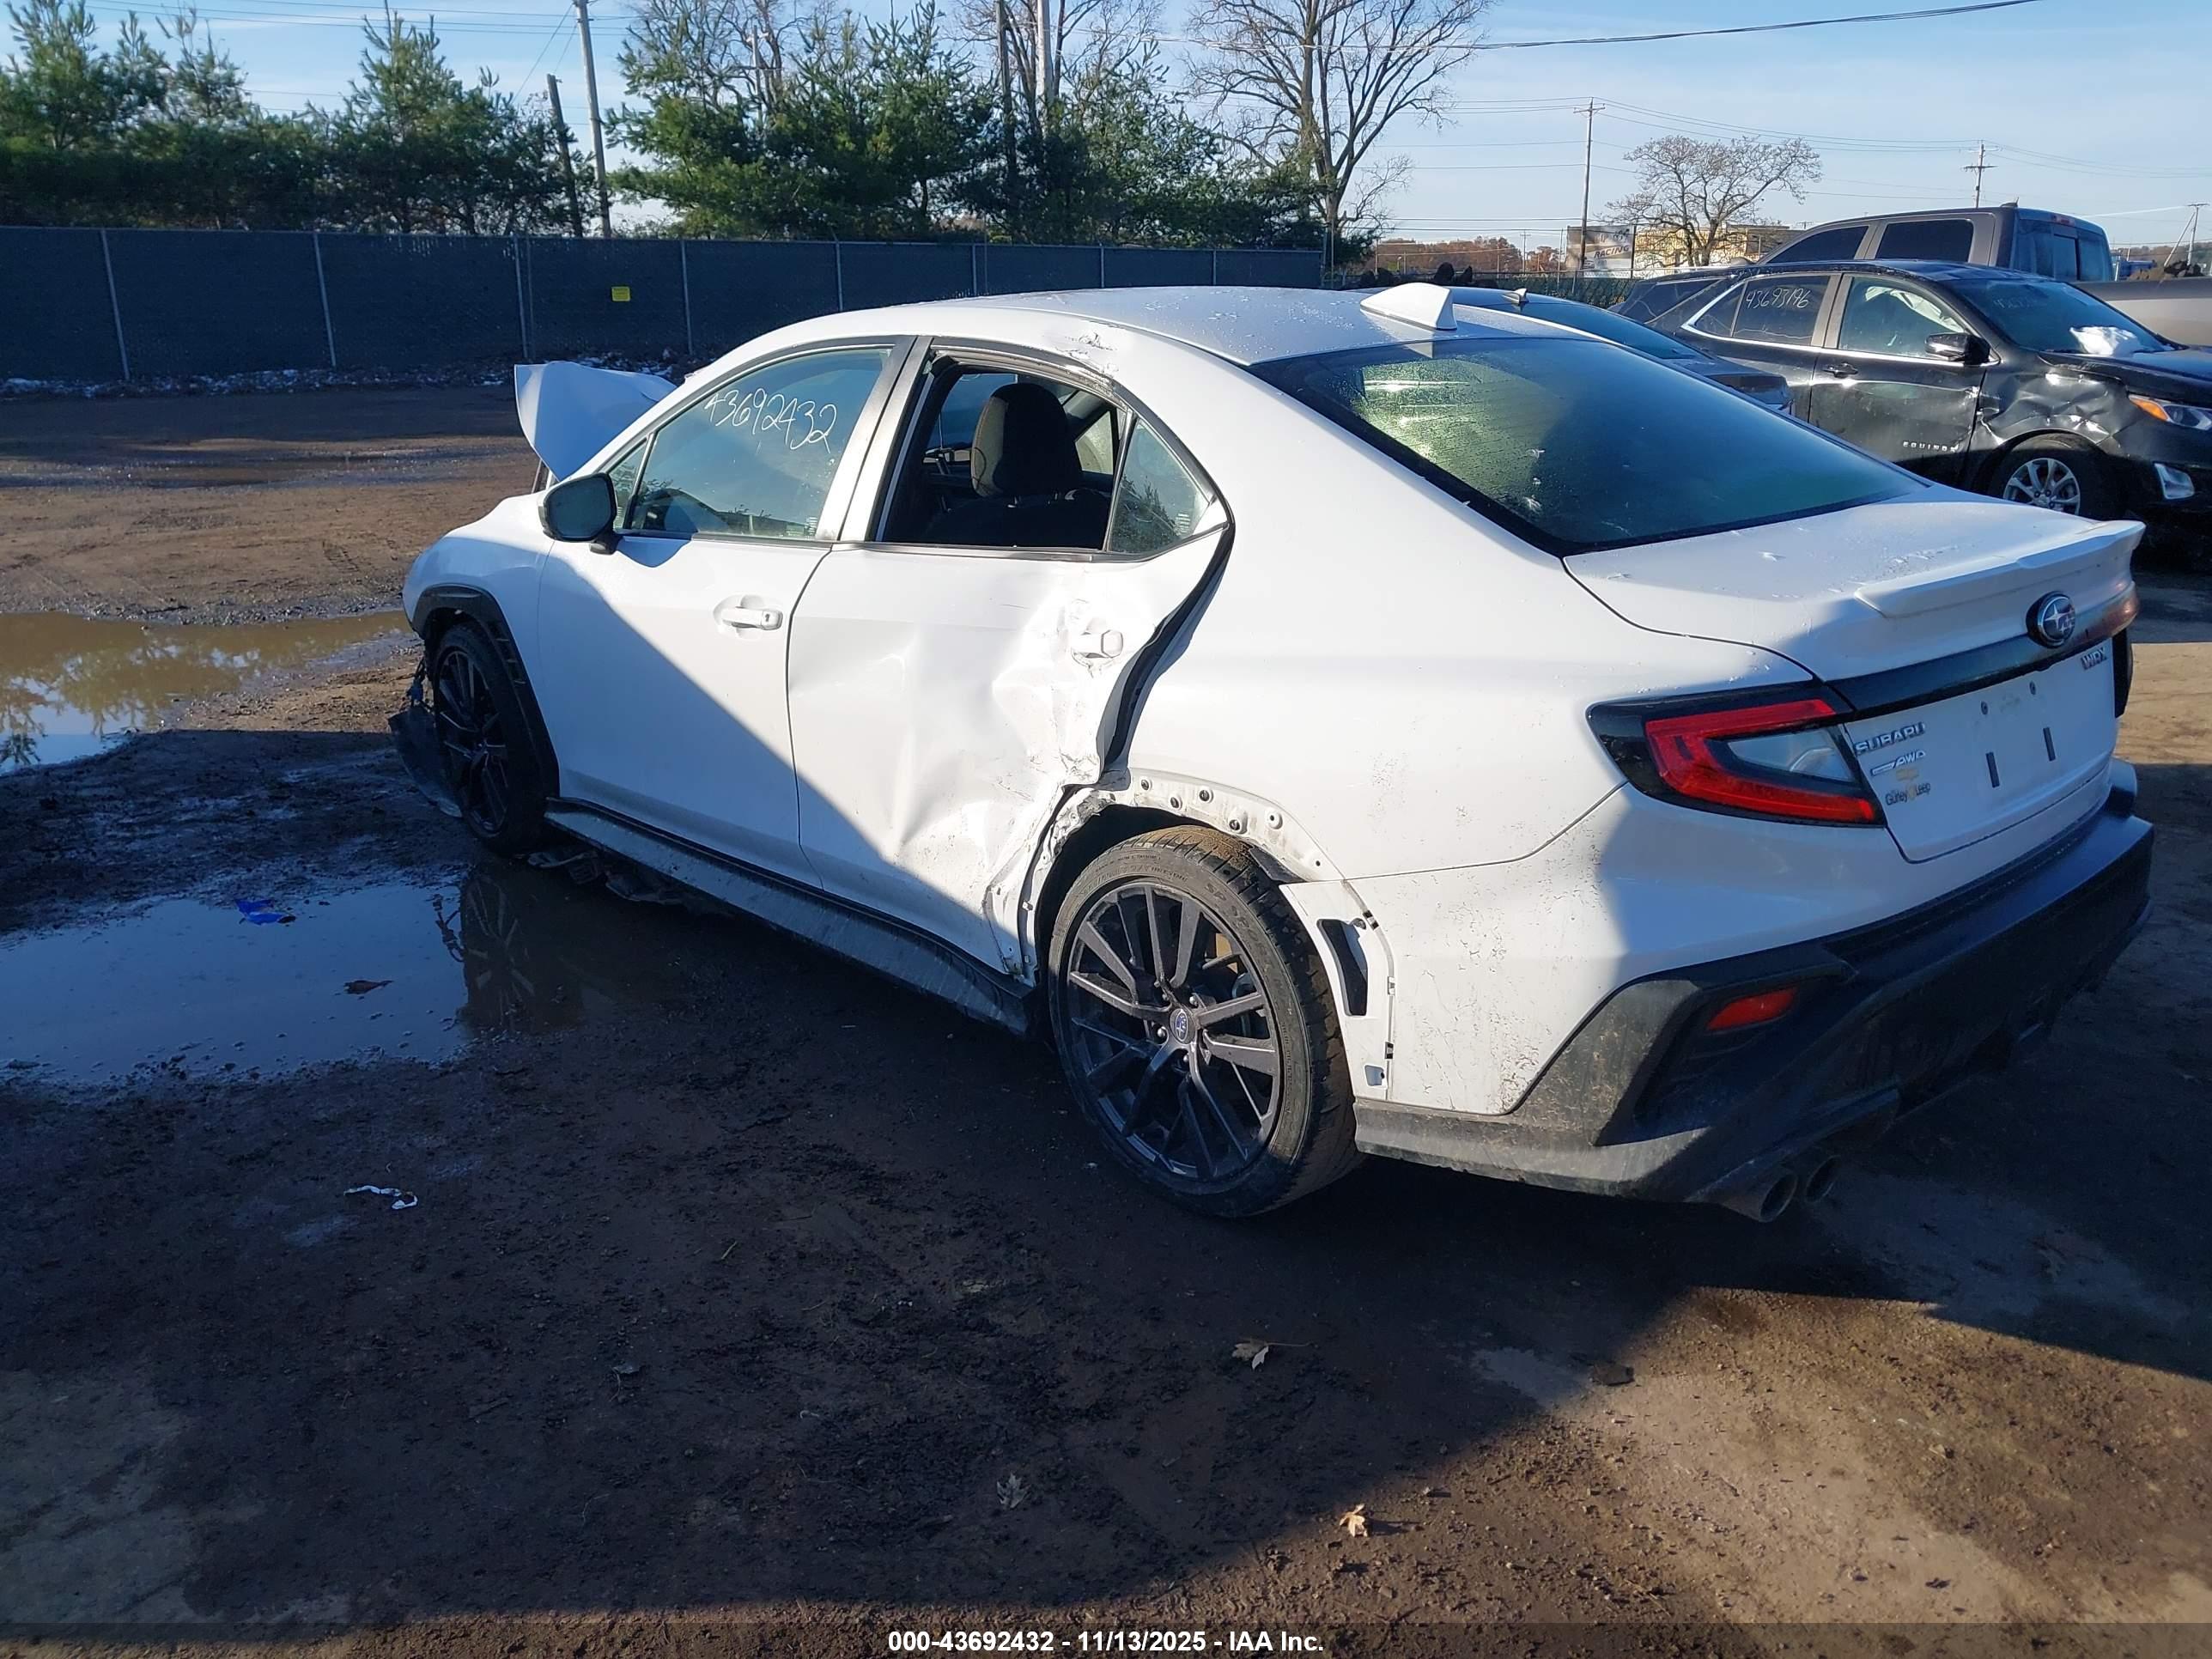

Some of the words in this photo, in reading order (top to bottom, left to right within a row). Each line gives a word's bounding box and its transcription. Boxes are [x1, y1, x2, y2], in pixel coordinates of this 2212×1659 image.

[1594, 246, 1630, 258] RACING
[1746, 288, 1811, 309] 43693196
[704, 388, 837, 453] 43692432
[1903, 441, 1960, 453] EQUINOX
[2081, 647, 2107, 670] WRX
[1854, 722, 1926, 756] SUBARU
[1895, 750, 1926, 767] AWD
